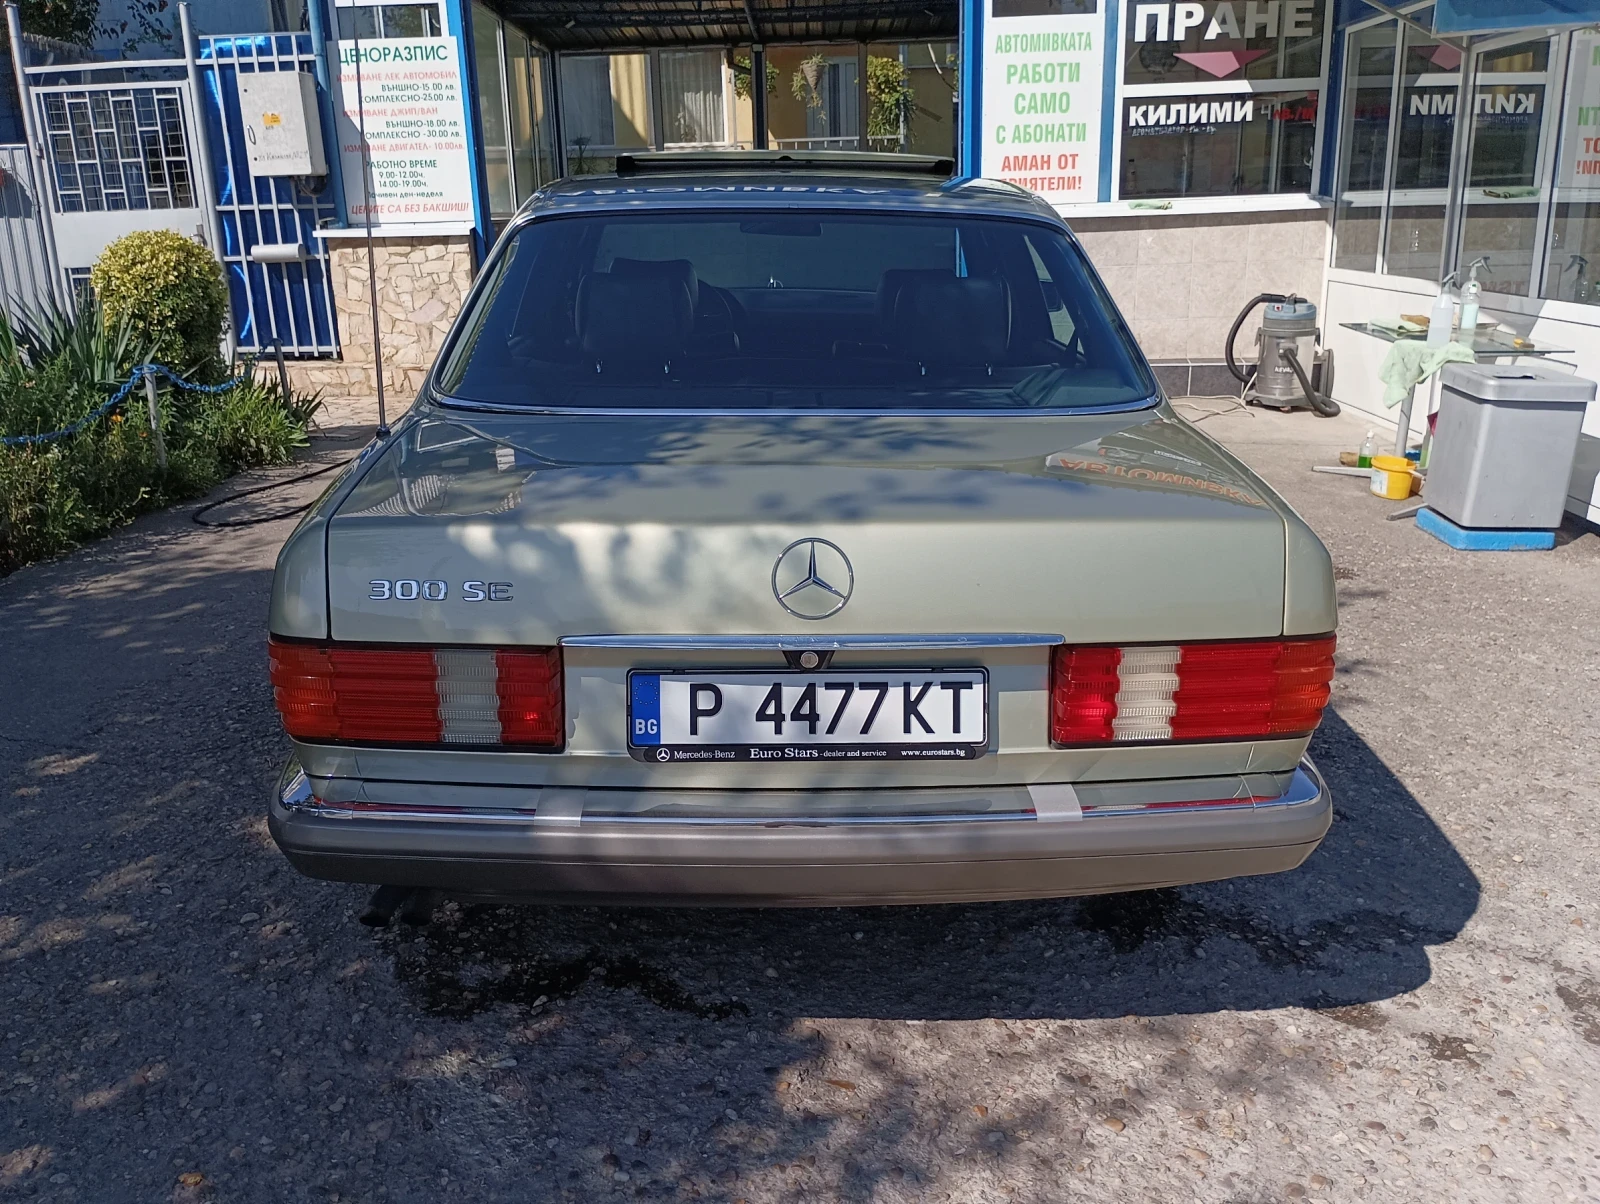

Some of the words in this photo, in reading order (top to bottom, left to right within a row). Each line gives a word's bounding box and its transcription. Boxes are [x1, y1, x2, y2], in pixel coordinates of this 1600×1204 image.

[1134, 1, 1315, 42] ПРАНЕ
[995, 32, 1092, 54] АВТОМИВКАТА
[338, 45, 448, 66] ЦЕНОРАЗПИС
[385, 72, 400, 81] ЛЕК
[403, 71, 457, 80] АВТОМОБИЛ
[1006, 62, 1080, 84] РАБОТИ
[362, 93, 443, 103] ОМПЛЕКСНО-25.00
[1014, 91, 1070, 115] САМО
[391, 107, 438, 117] ДЖИП/ВАН
[1129, 101, 1253, 127] КИЛИМИ
[364, 130, 420, 140] ОМПЛЕКСНО
[996, 125, 1006, 144] С
[1011, 123, 1086, 143] АБОНАТИ
[409, 159, 437, 168] ВРЕМЕ
[1001, 155, 1051, 171] АМАН
[1057, 153, 1079, 170] ОТ
[1001, 176, 1082, 191] РИЯТЕЛИ!
[388, 204, 401, 214] СА
[404, 203, 420, 213] БЕЗ
[423, 202, 469, 213] БАКШИШ!
[368, 579, 448, 601] 300
[462, 580, 514, 602] SE
[635, 719, 658, 735] BG
[674, 750, 736, 759] Mercedes-Benz
[750, 748, 781, 759] Euro
[785, 748, 819, 758] Stars
[901, 749, 966, 757] www.eurostars.bg
